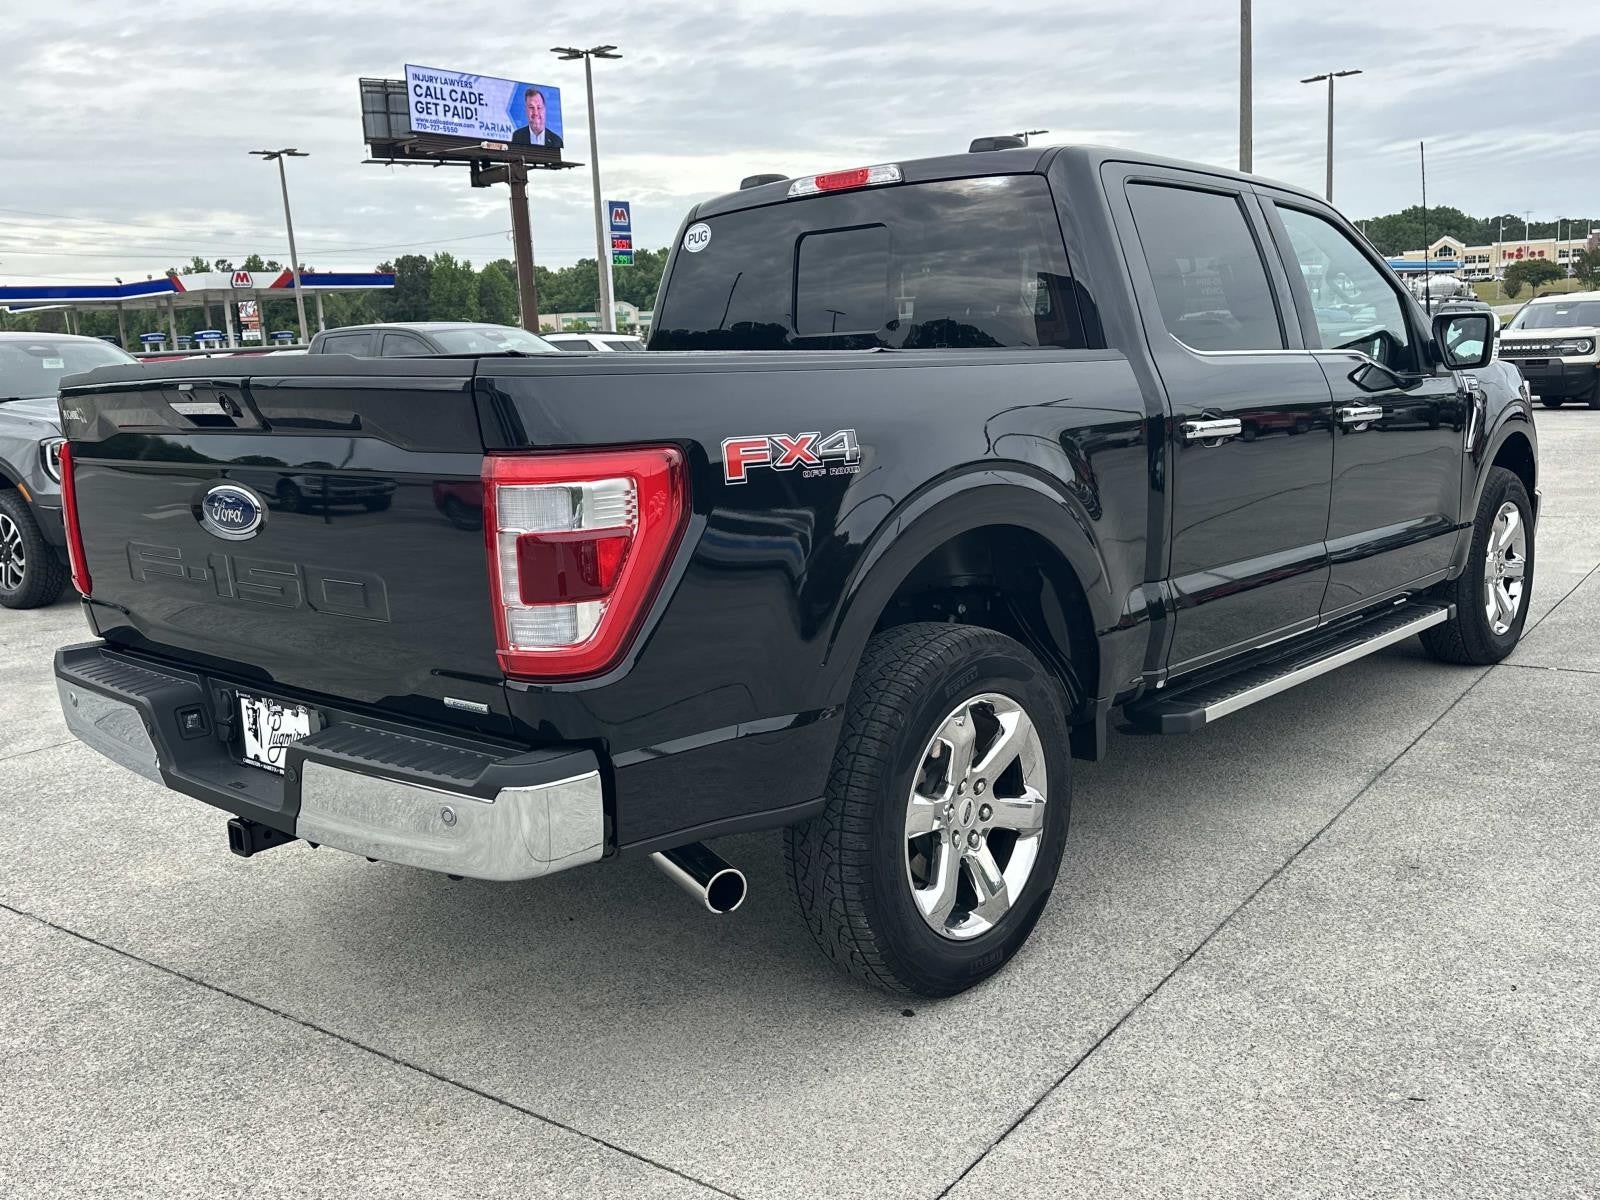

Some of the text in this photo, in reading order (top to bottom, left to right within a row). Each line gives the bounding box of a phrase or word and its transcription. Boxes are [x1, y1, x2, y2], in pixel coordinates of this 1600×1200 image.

[412, 73, 472, 89] INJURY LAWYERS
[413, 84, 488, 107] CALL CADE.
[415, 101, 478, 121] GET PAID!
[479, 121, 512, 133] PARIAN
[688, 230, 708, 245] PUG
[721, 429, 860, 485] FX4
[803, 466, 860, 478] OFF ROAD
[212, 495, 244, 523] Ford
[127, 541, 391, 623] F-150
